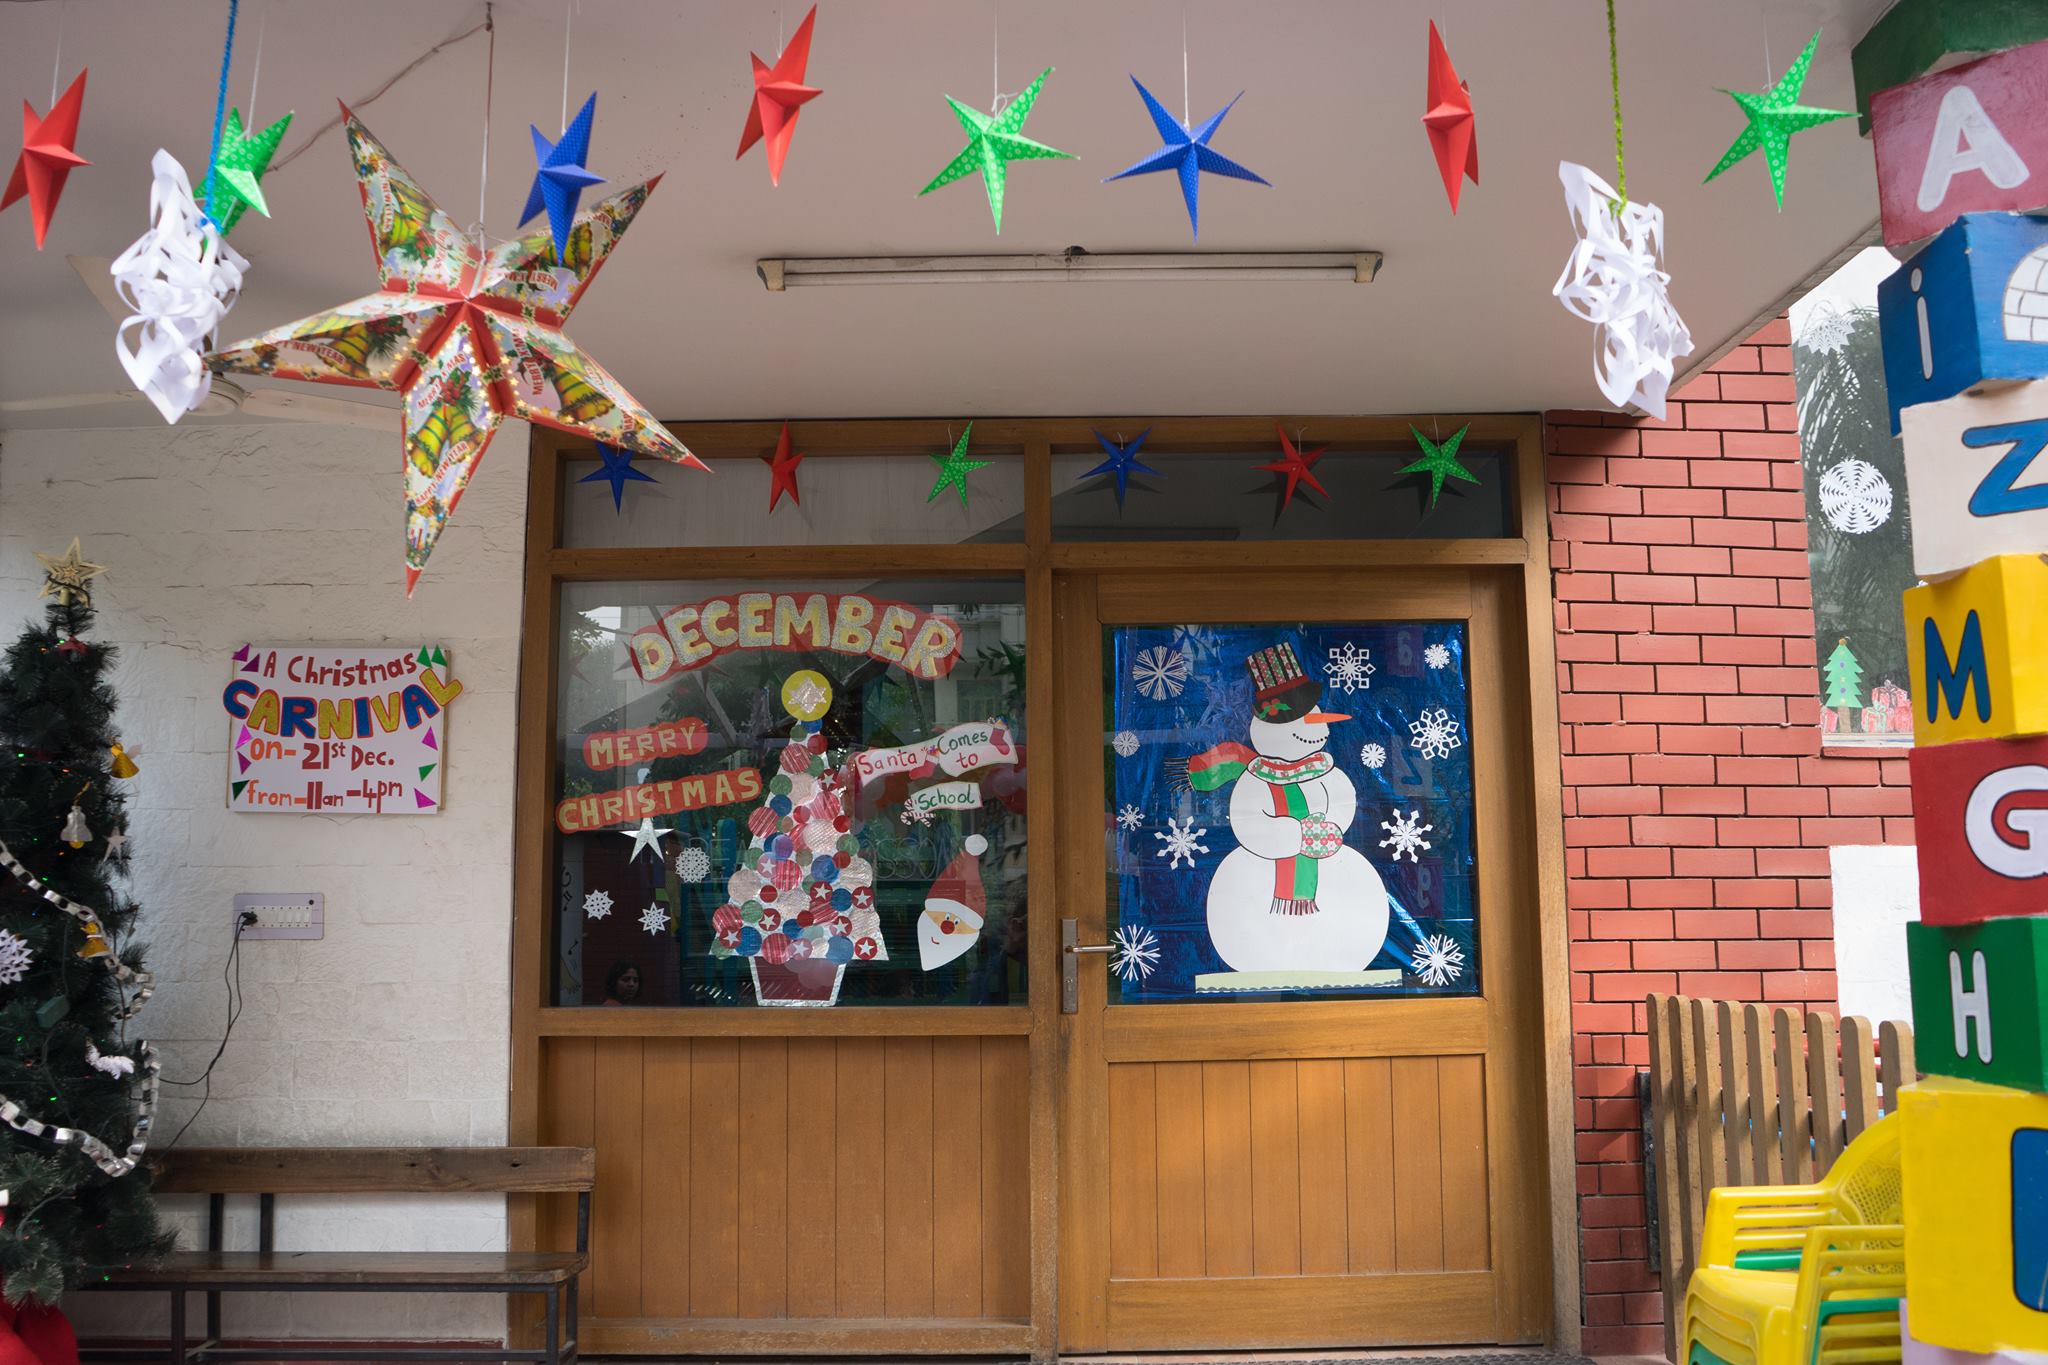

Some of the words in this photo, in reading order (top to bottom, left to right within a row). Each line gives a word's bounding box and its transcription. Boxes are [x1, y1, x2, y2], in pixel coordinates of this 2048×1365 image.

[1917, 86, 2029, 212] A
[1961, 418, 2048, 517] Z
[631, 593, 957, 680] DECEMBER
[1924, 610, 1993, 724] M
[263, 651, 277, 678] A
[287, 652, 417, 687] Christmas
[223, 668, 463, 739] CARNIVAL
[351, 744, 395, 771] Dec.
[590, 725, 698, 767] MERRY
[858, 750, 918, 775] Santa
[937, 731, 989, 755] Comes
[956, 753, 979, 769] to
[558, 773, 760, 828] CHRISTMAS
[917, 784, 975, 811] School
[1965, 765, 2048, 879] G
[1949, 949, 1994, 1066] H
